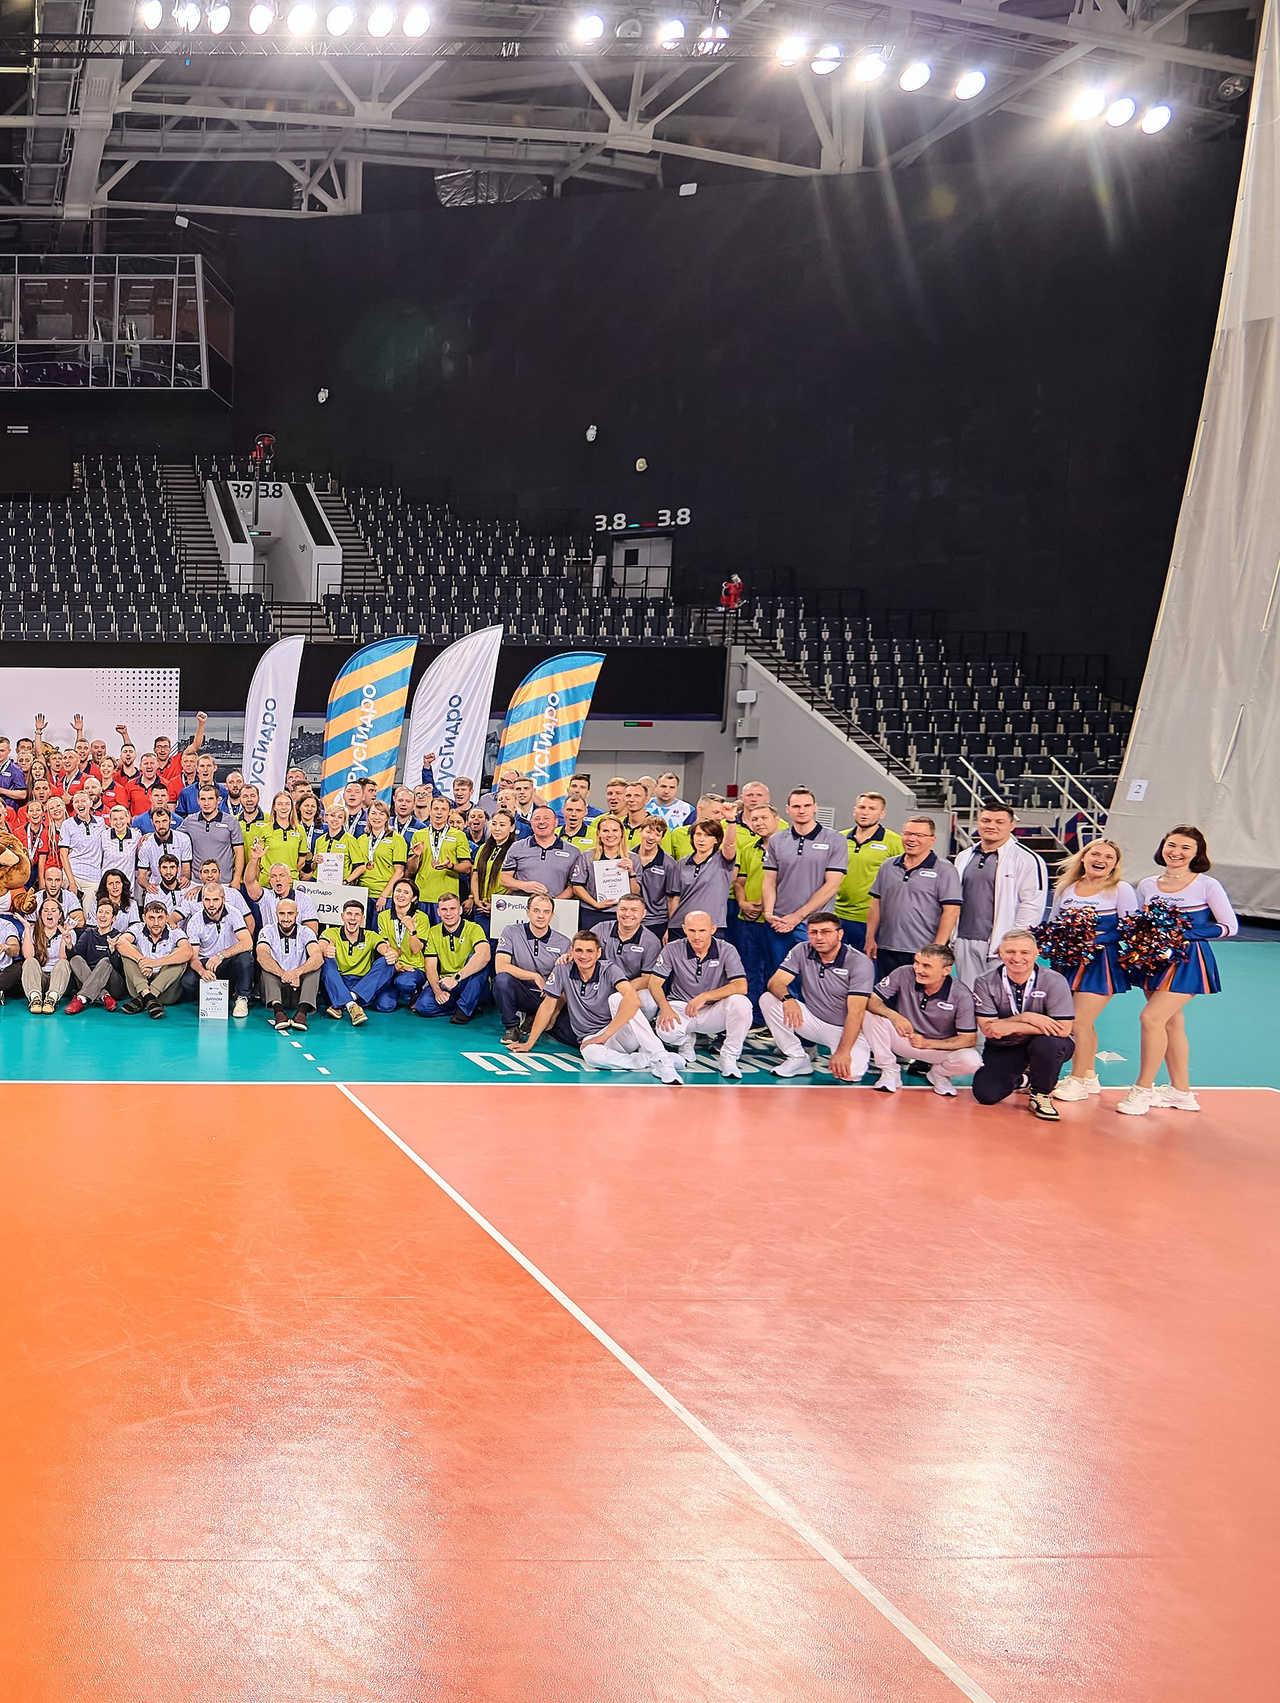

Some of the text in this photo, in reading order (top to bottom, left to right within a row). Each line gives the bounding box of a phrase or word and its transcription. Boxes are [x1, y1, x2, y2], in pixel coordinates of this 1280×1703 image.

[259, 483, 283, 499] 3.8
[594, 507, 691, 532] 3.8 3.8
[250, 697, 278, 786] усГидро
[347, 683, 378, 784] РусГидро
[436, 694, 463, 793] РусГидро
[1133, 784, 1142, 794] 2
[306, 888, 333, 896] РусГидро
[317, 903, 340, 914] ДЭК
